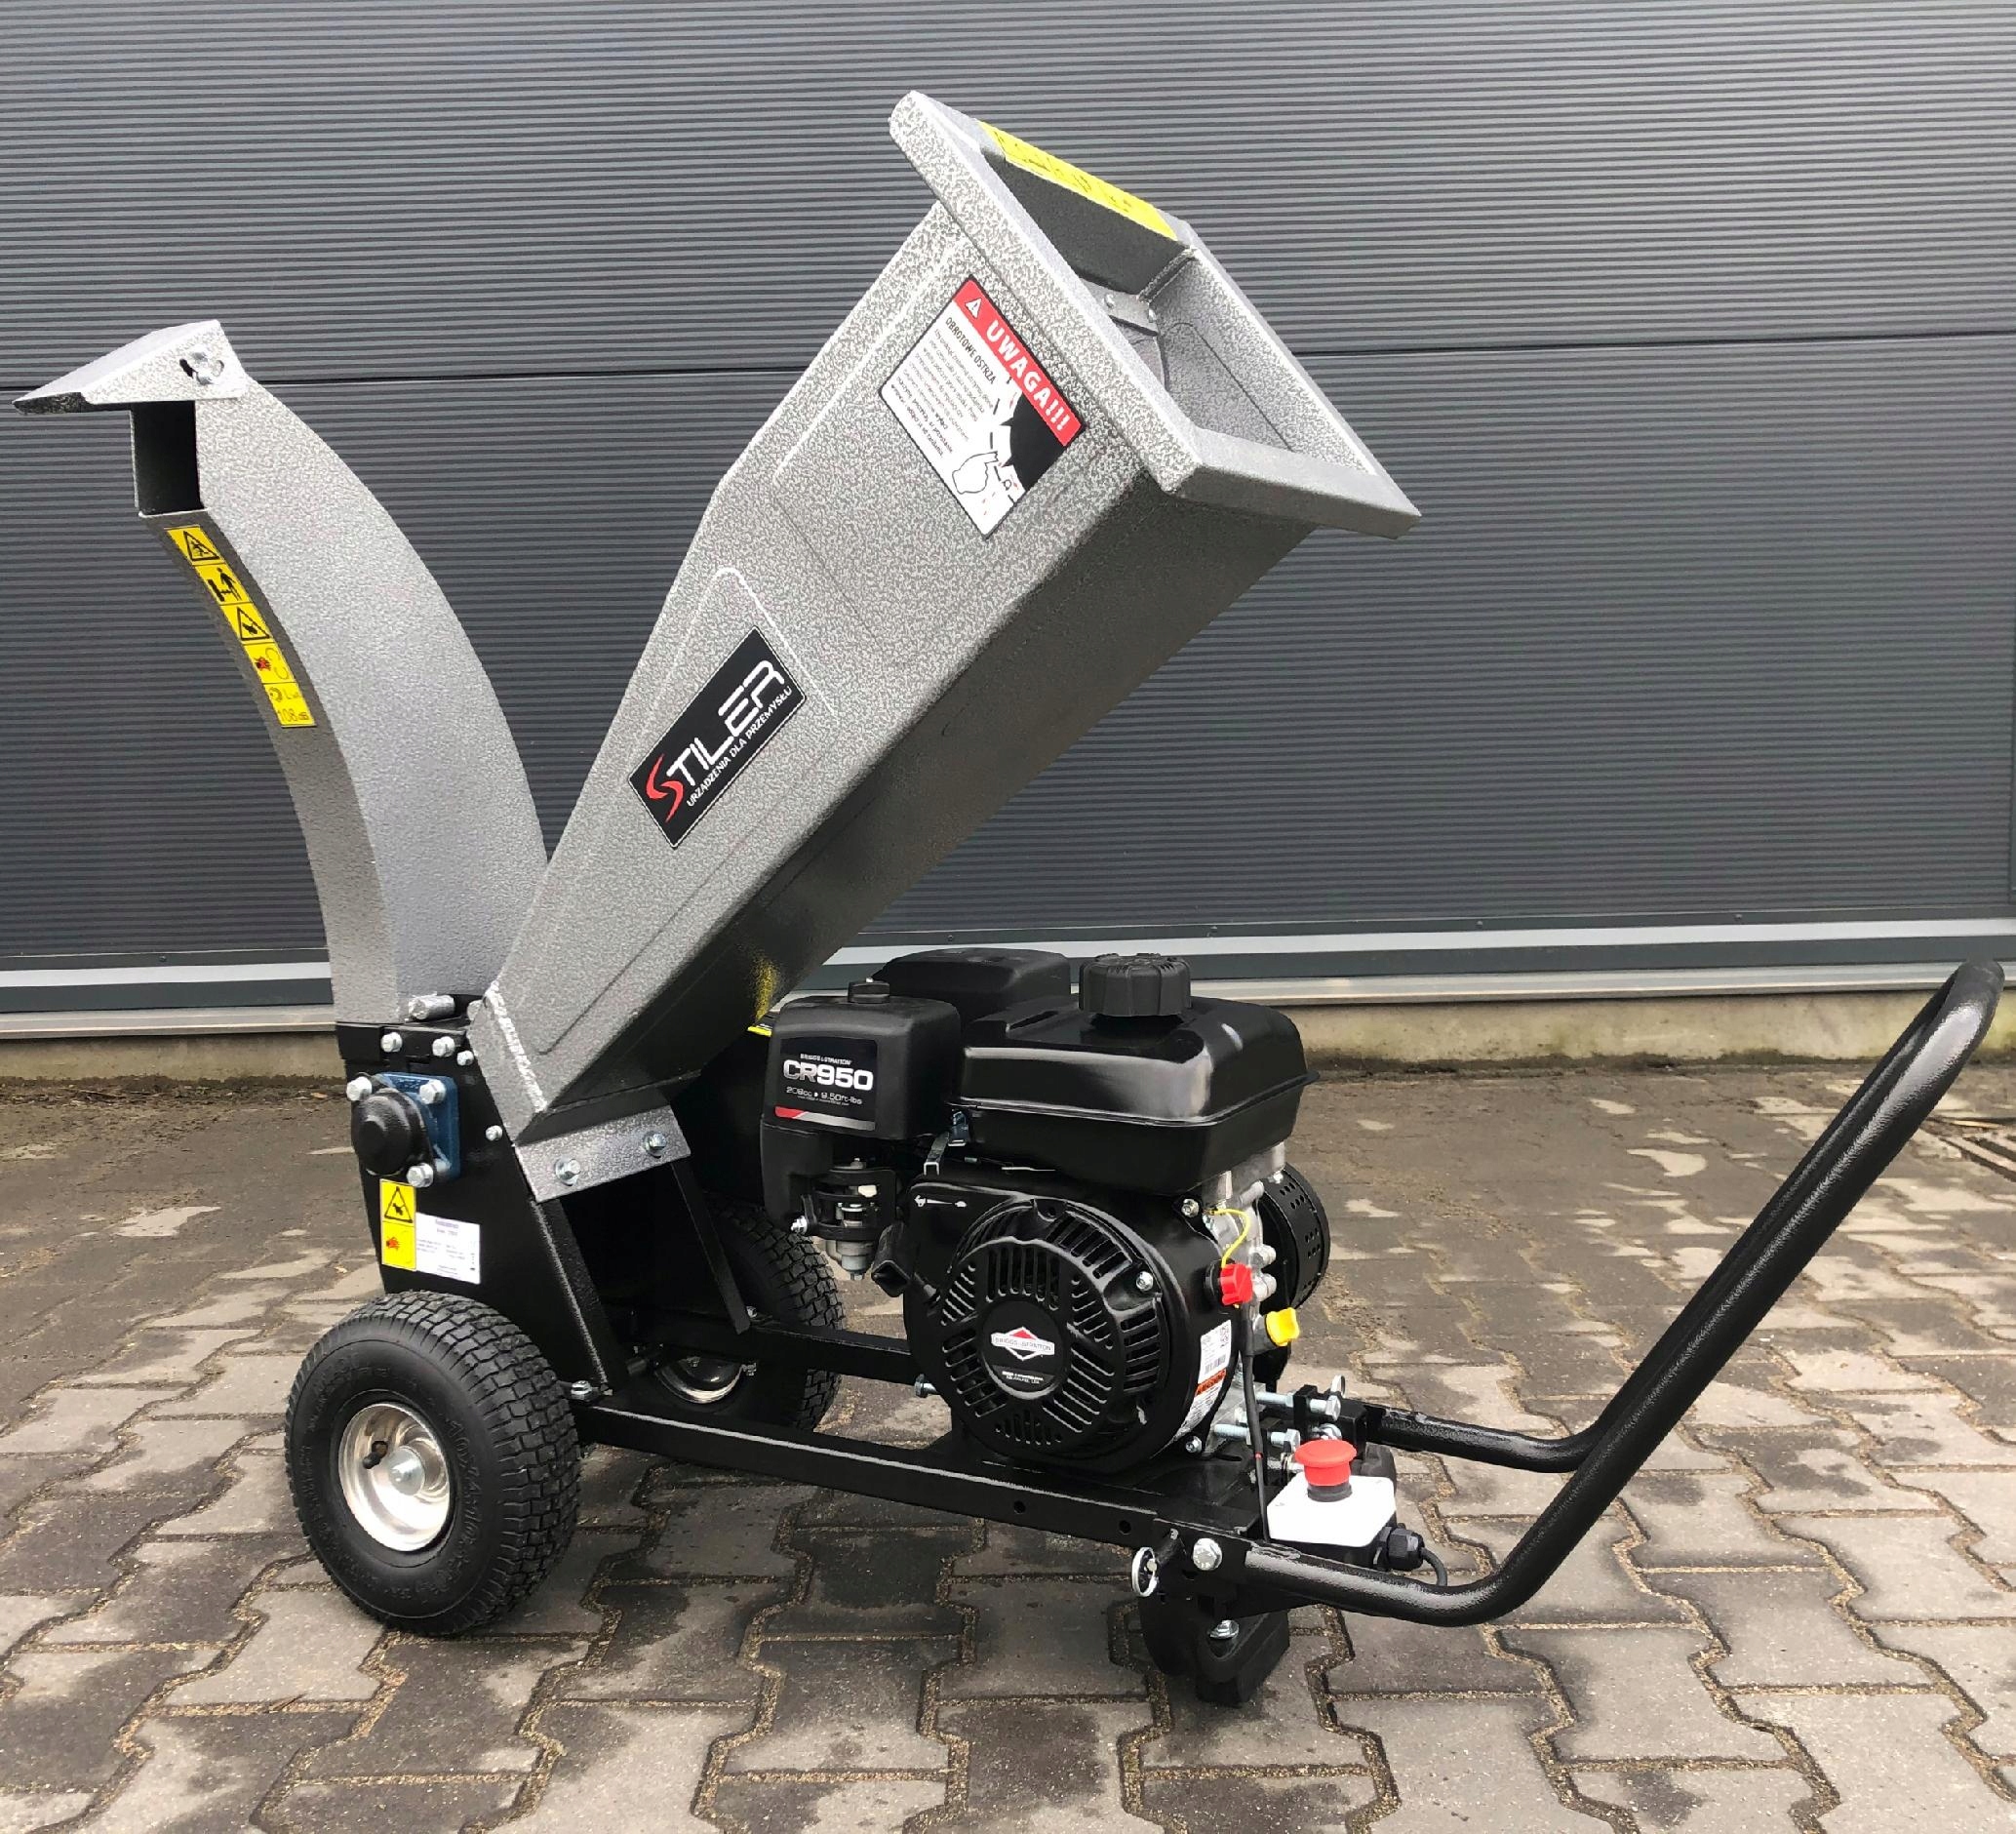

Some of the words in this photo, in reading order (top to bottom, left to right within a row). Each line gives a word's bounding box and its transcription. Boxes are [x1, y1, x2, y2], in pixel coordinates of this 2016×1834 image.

[945, 317, 975, 358] OBROTOWE
[973, 354, 997, 385] OSTRZA
[986, 319, 1071, 431] UWAGA!!!
[646, 659, 784, 823] STILER
[686, 756, 731, 807] URZĄDZENIA
[729, 738, 747, 758] DLA
[745, 686, 792, 739] PRZEMYSŁU
[783, 1058, 874, 1092] CR950
